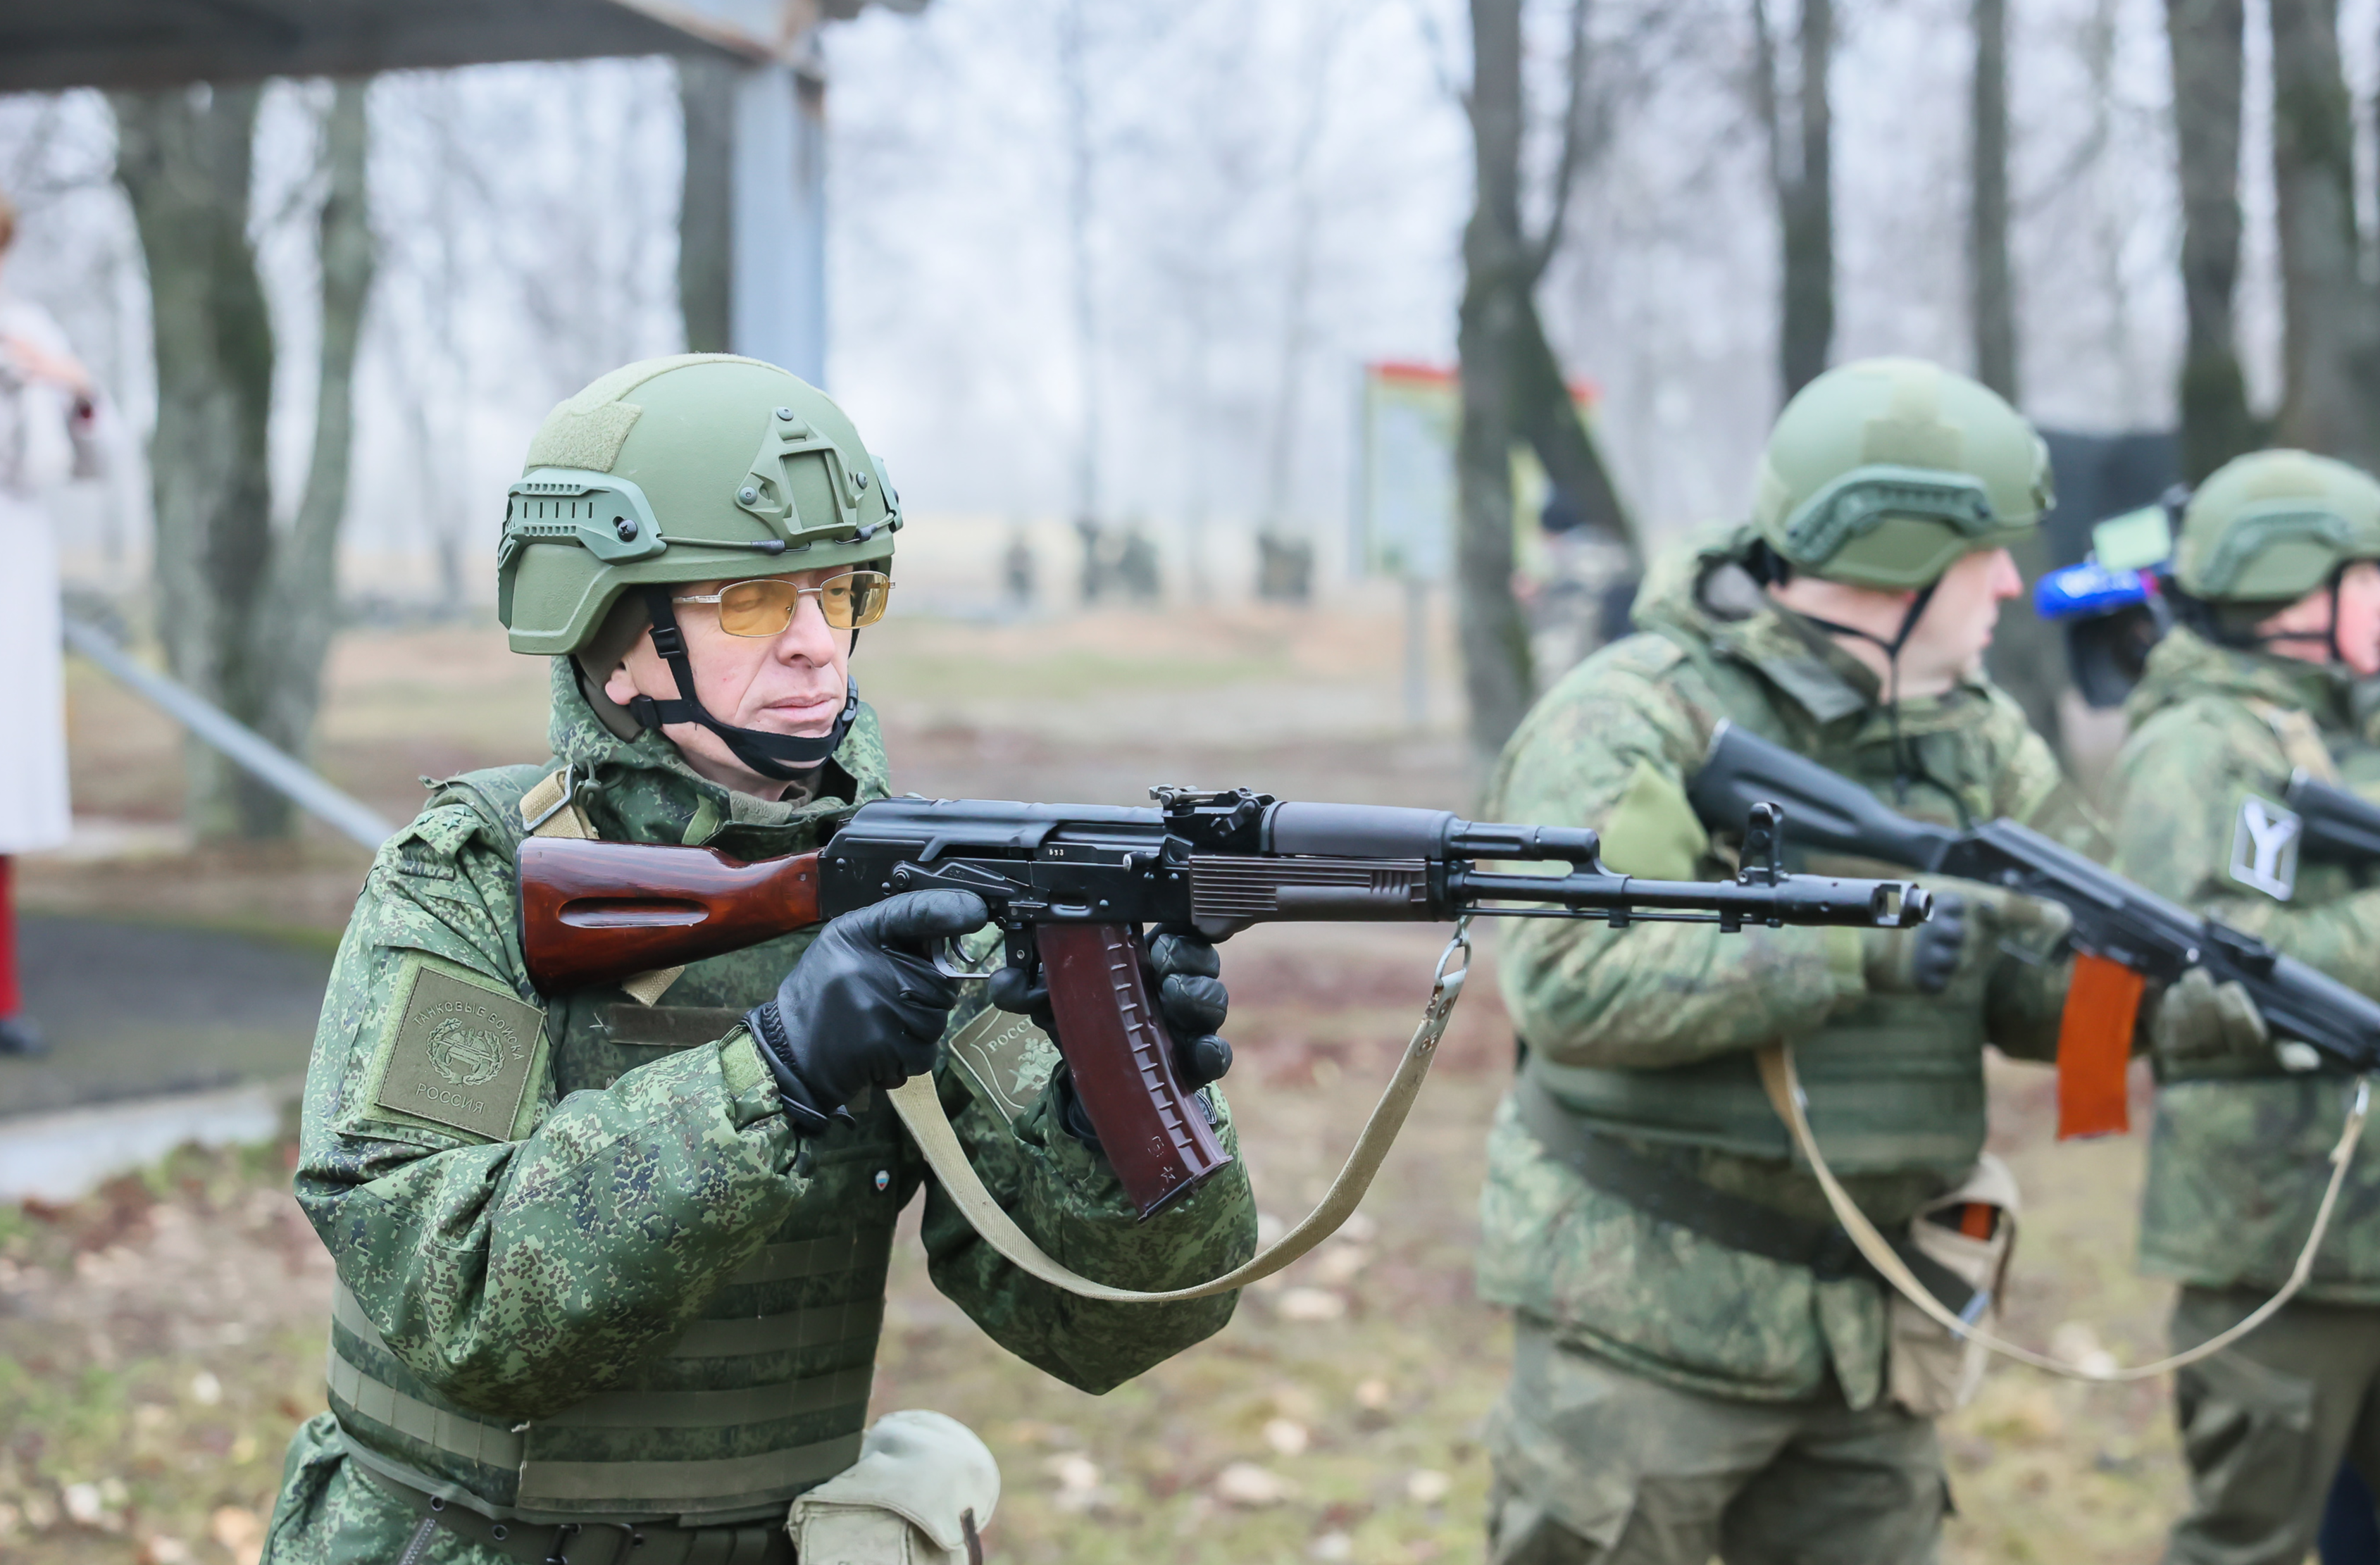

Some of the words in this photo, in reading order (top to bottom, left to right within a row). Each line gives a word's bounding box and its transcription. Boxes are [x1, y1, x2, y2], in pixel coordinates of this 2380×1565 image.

[2245, 802, 2298, 884] Y
[413, 1001, 486, 1028] ТАНКОВЫЕ
[487, 1012, 525, 1061] ВОЙСКА
[416, 1083, 485, 1114] РОССИЯ
